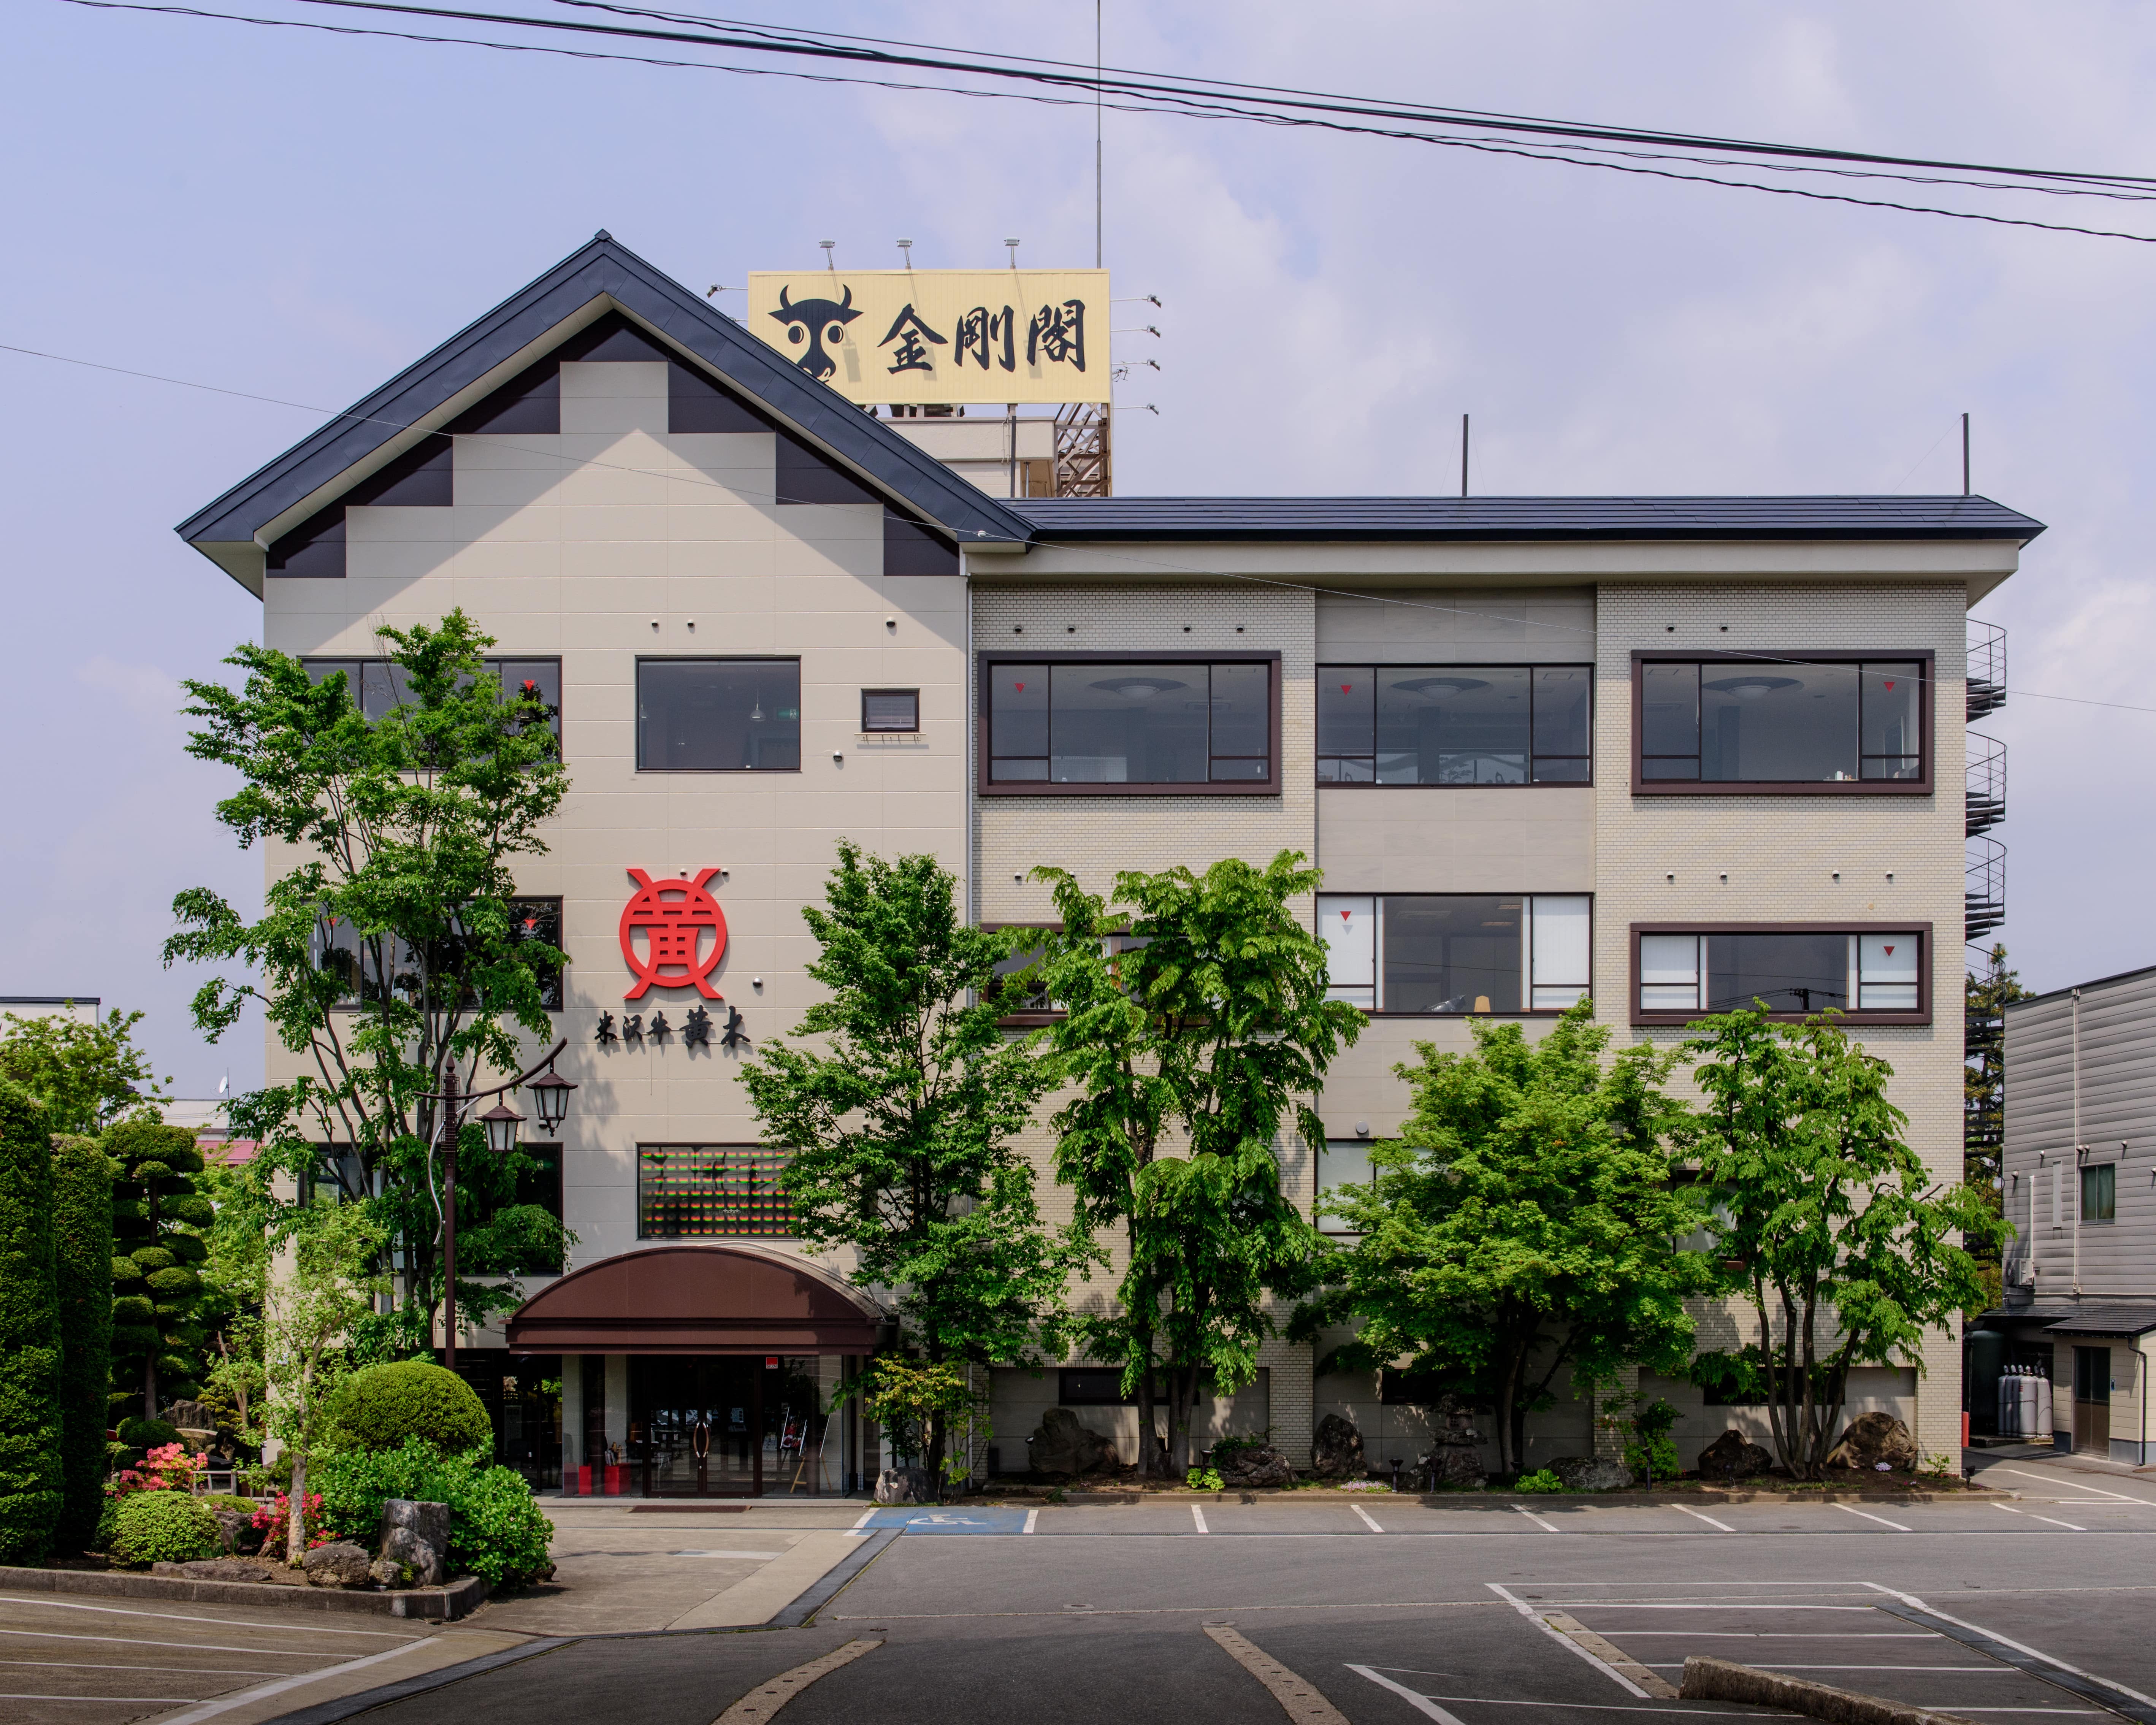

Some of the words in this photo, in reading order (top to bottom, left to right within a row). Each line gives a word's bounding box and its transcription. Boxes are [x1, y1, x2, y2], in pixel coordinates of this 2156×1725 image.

[877, 300, 1085, 374] 金剛閣
[594, 1005, 750, 1048] 米沢牛黄木
